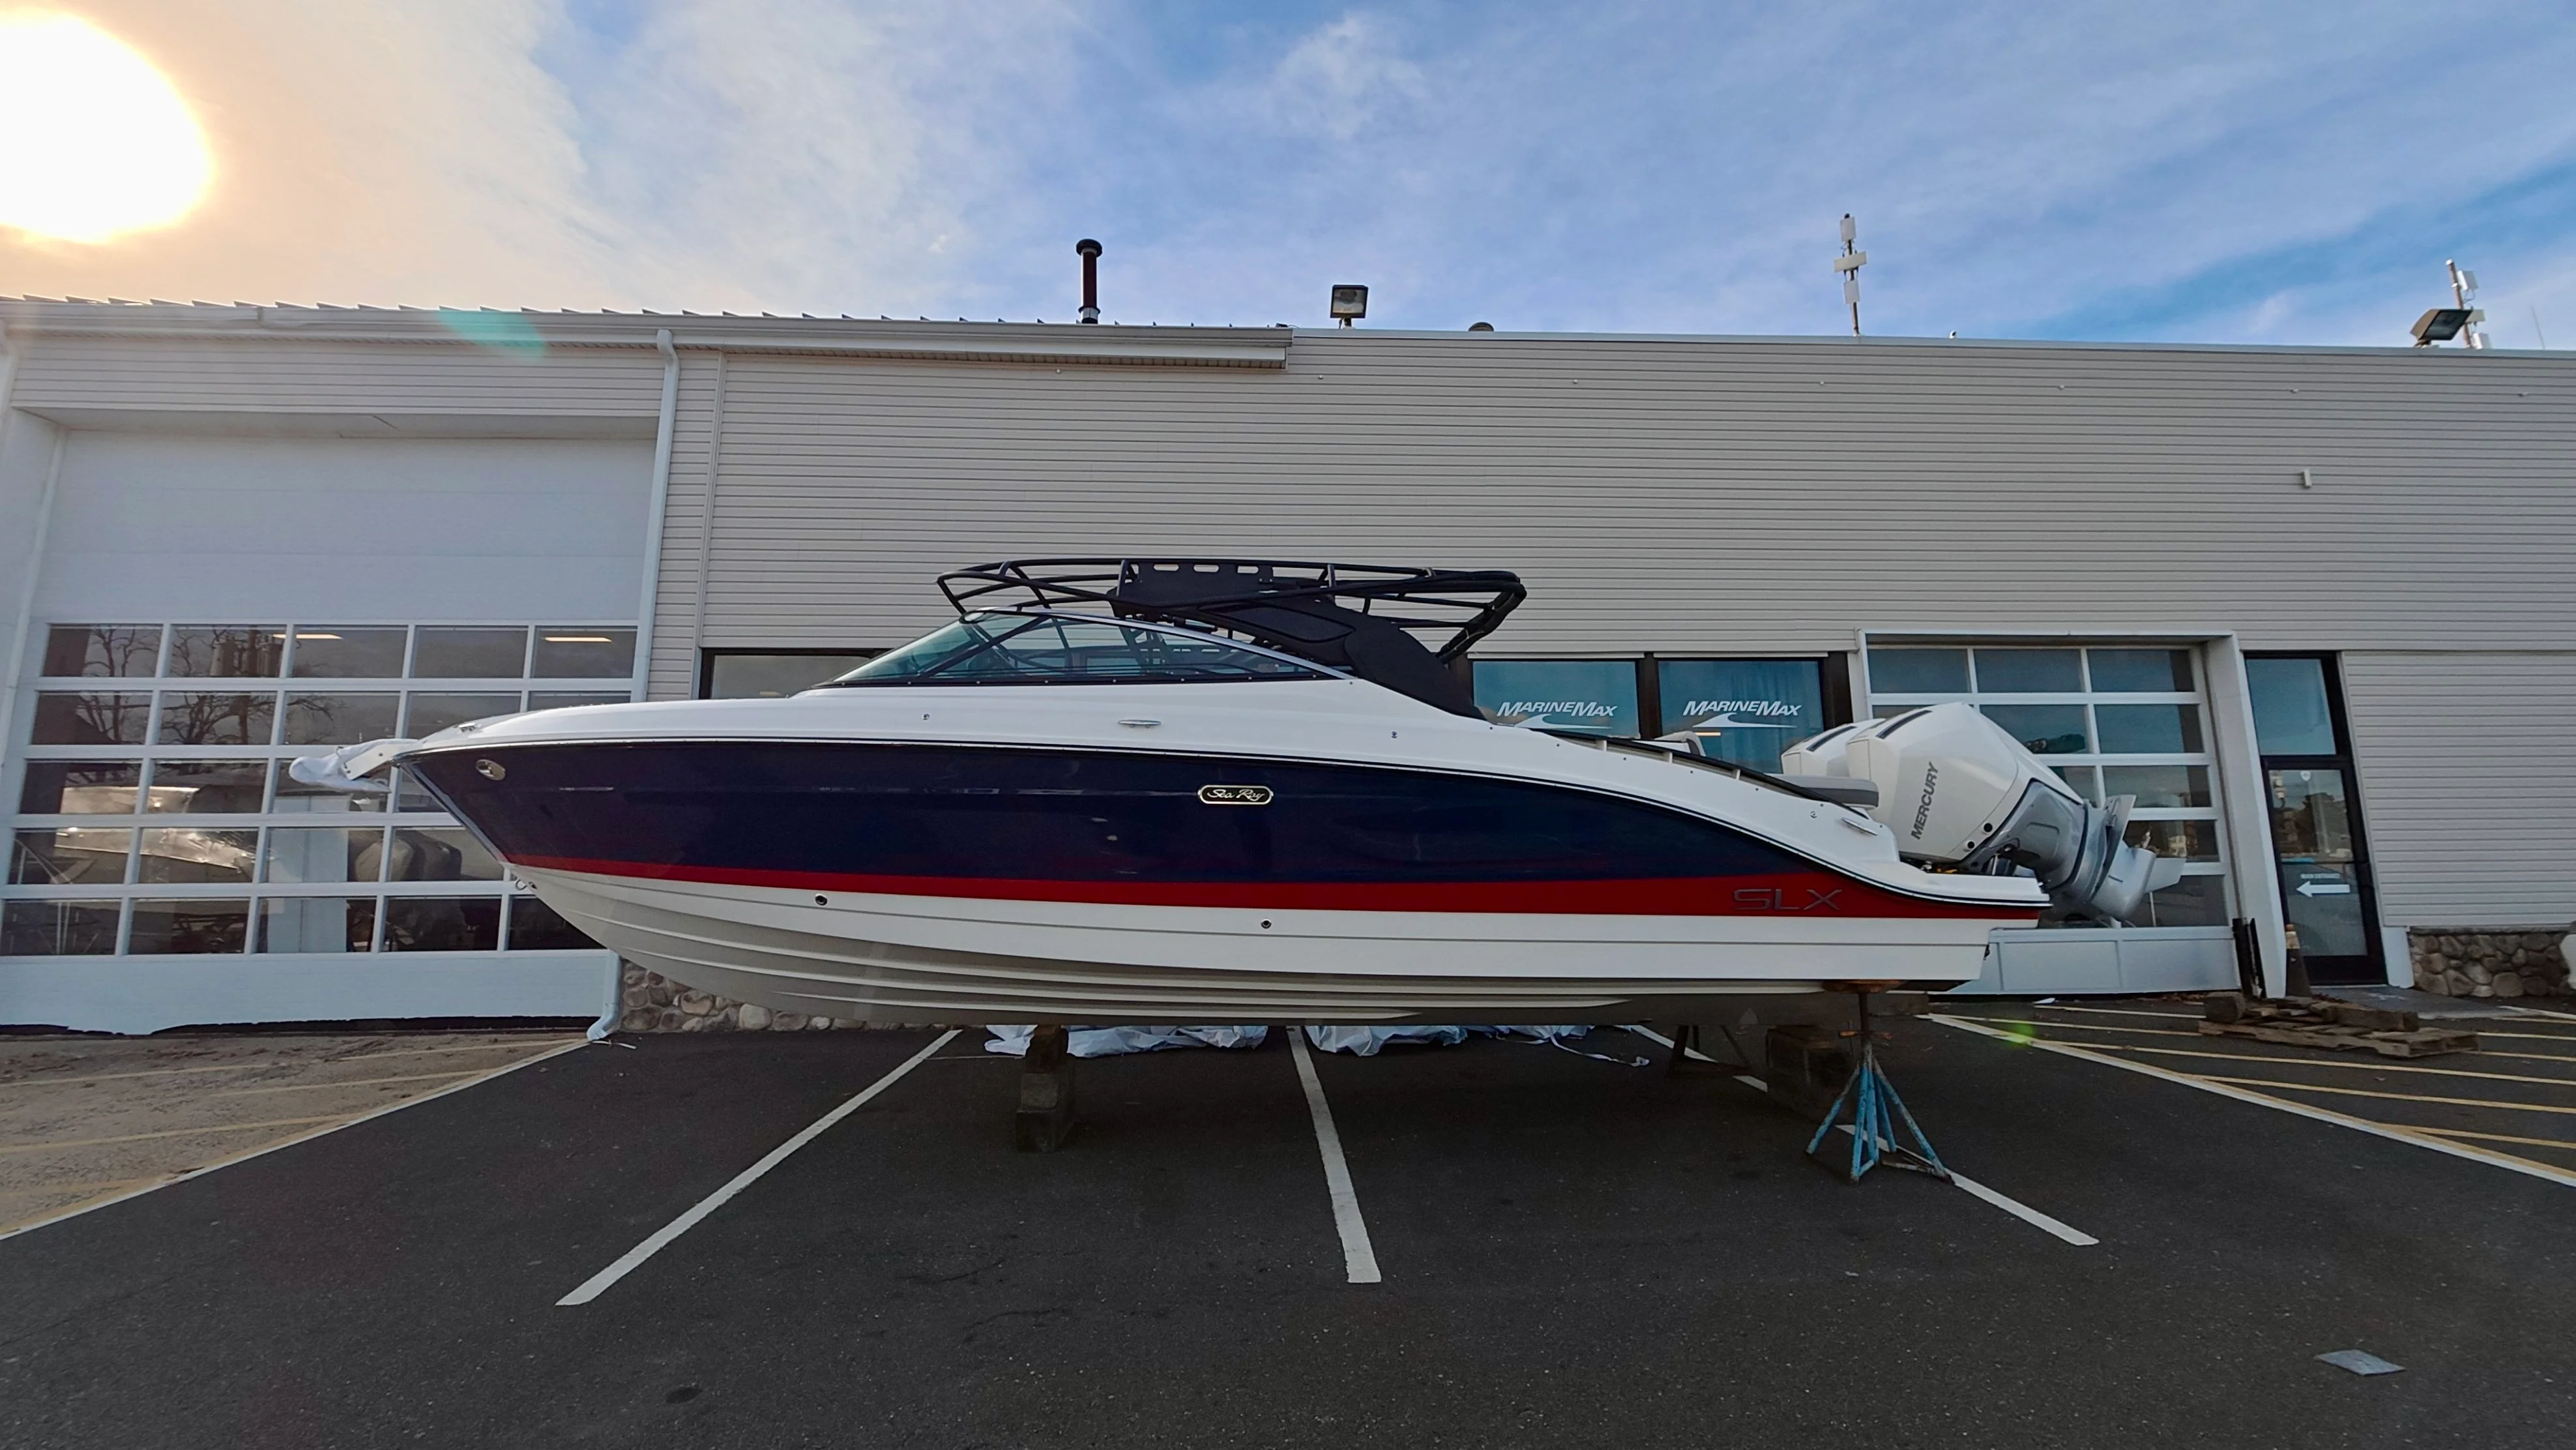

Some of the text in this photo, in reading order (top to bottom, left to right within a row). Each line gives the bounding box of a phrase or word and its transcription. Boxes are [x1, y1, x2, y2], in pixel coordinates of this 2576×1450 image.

[1207, 789, 1265, 801] Sea Ray
[1910, 761, 1938, 840] MERCURY
[1734, 889, 1843, 910] SLX
